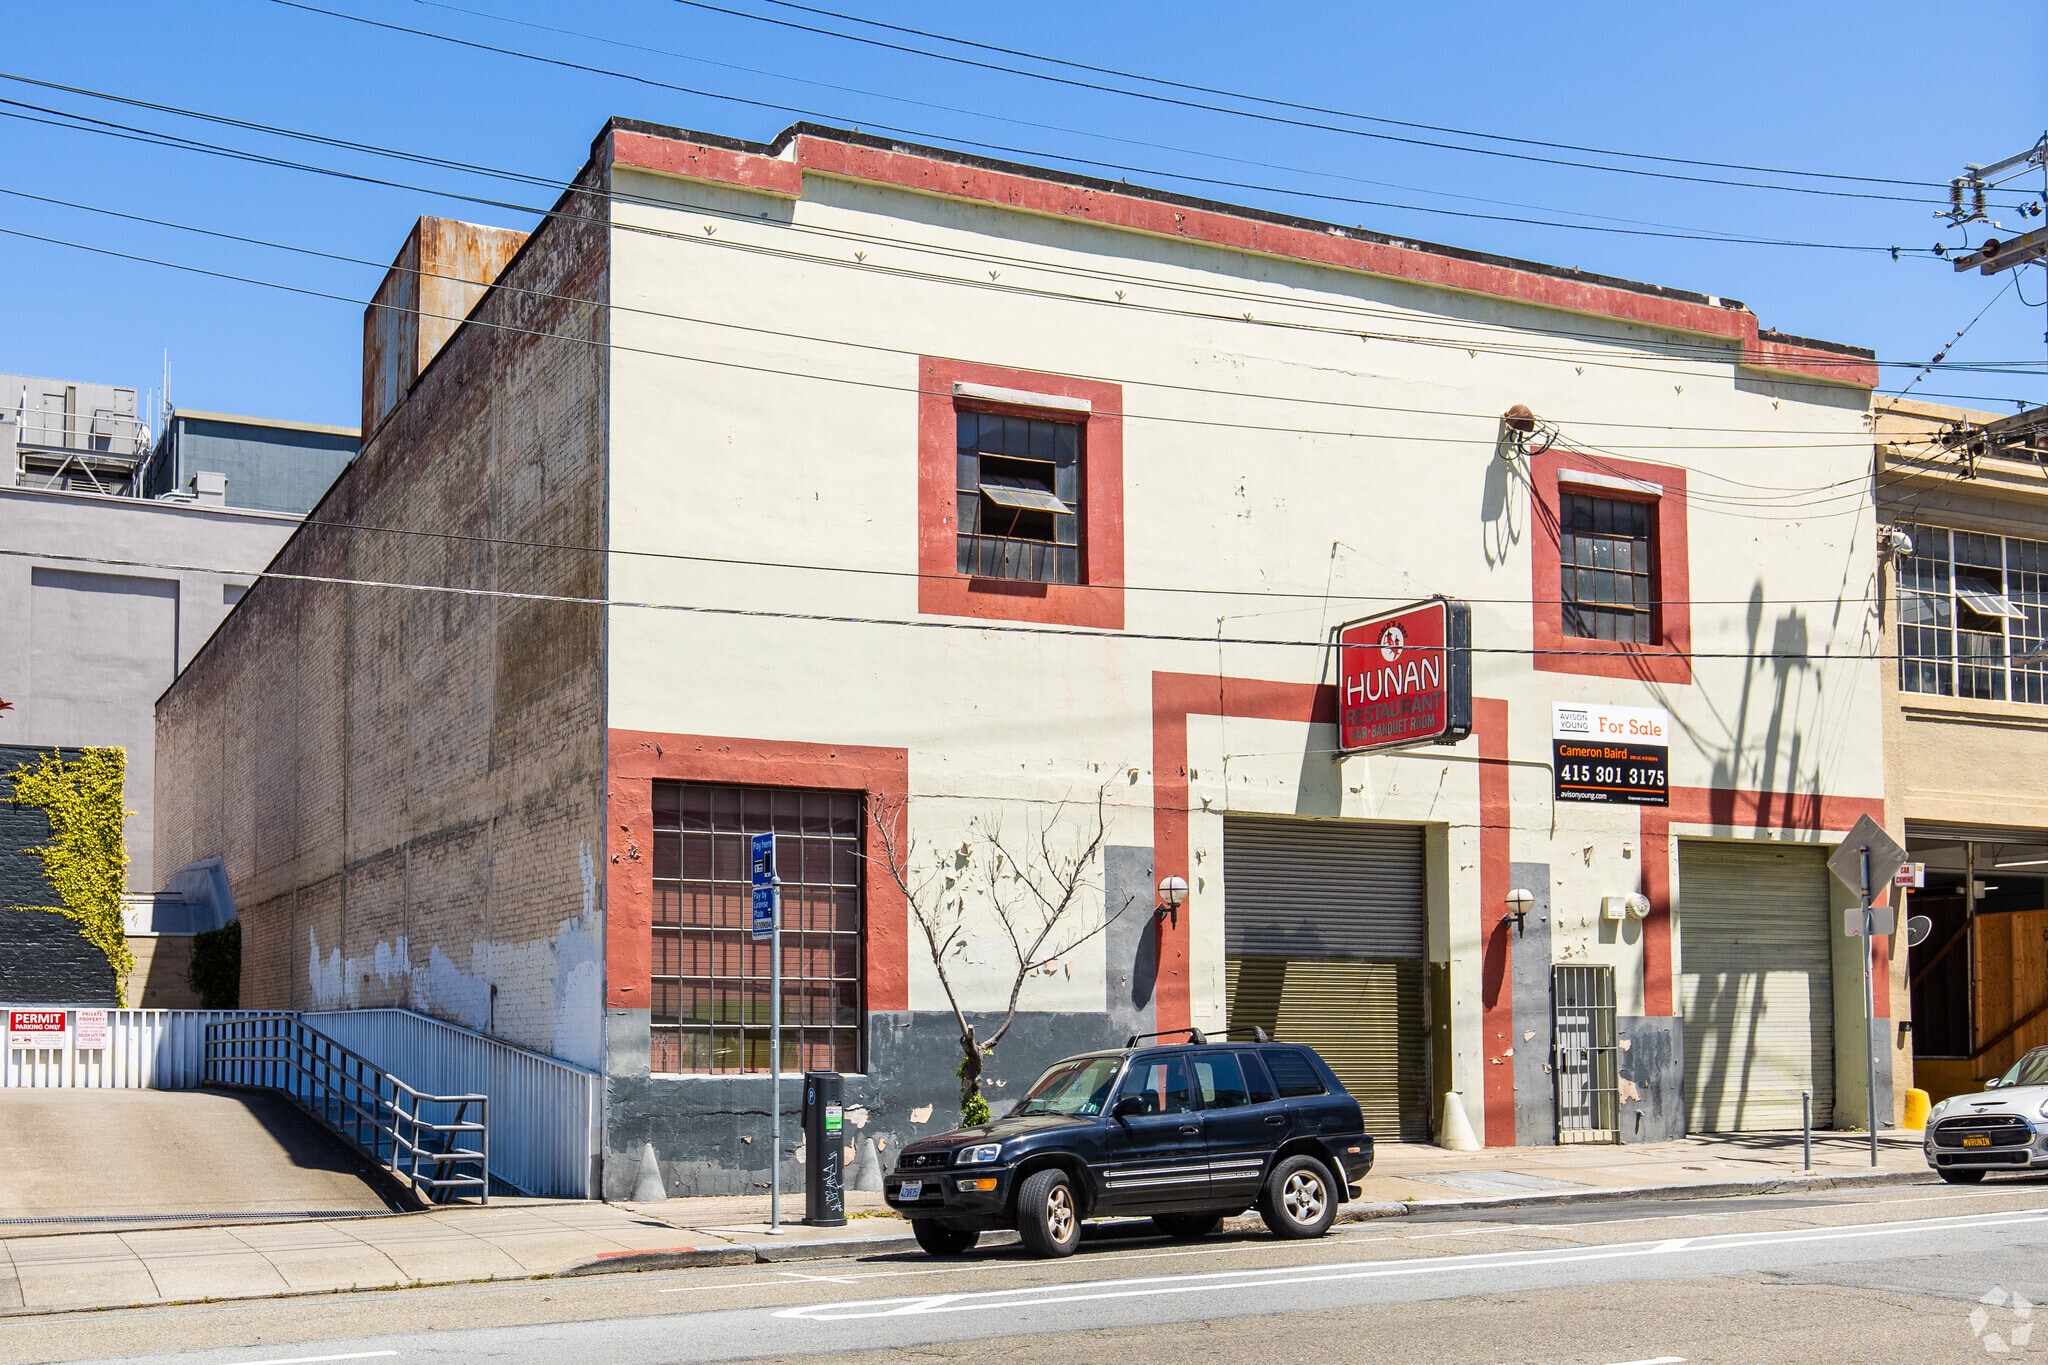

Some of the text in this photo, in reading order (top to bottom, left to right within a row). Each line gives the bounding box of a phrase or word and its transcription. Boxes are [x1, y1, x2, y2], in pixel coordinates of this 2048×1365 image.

[1346, 655, 1440, 706] HUNAN
[1345, 690, 1443, 727] RESTAURANT
[1410, 713, 1435, 731] ROOM
[1560, 713, 1662, 737] AVISON For Sale
[1560, 721, 1588, 730] YOUNG
[1559, 744, 1602, 758] Cameron
[1604, 747, 1628, 760] Baird
[1561, 764, 1665, 786] 415 301 3175
[1560, 790, 1607, 801] avisonyoung.com
[753, 839, 772, 852] Pay here
[1900, 866, 1910, 874] CAR
[1896, 876, 1914, 884] COMING
[753, 890, 767, 901] Pay by
[754, 901, 768, 909] License
[754, 910, 764, 918] Plate
[15, 1013, 61, 1024] PERMIT
